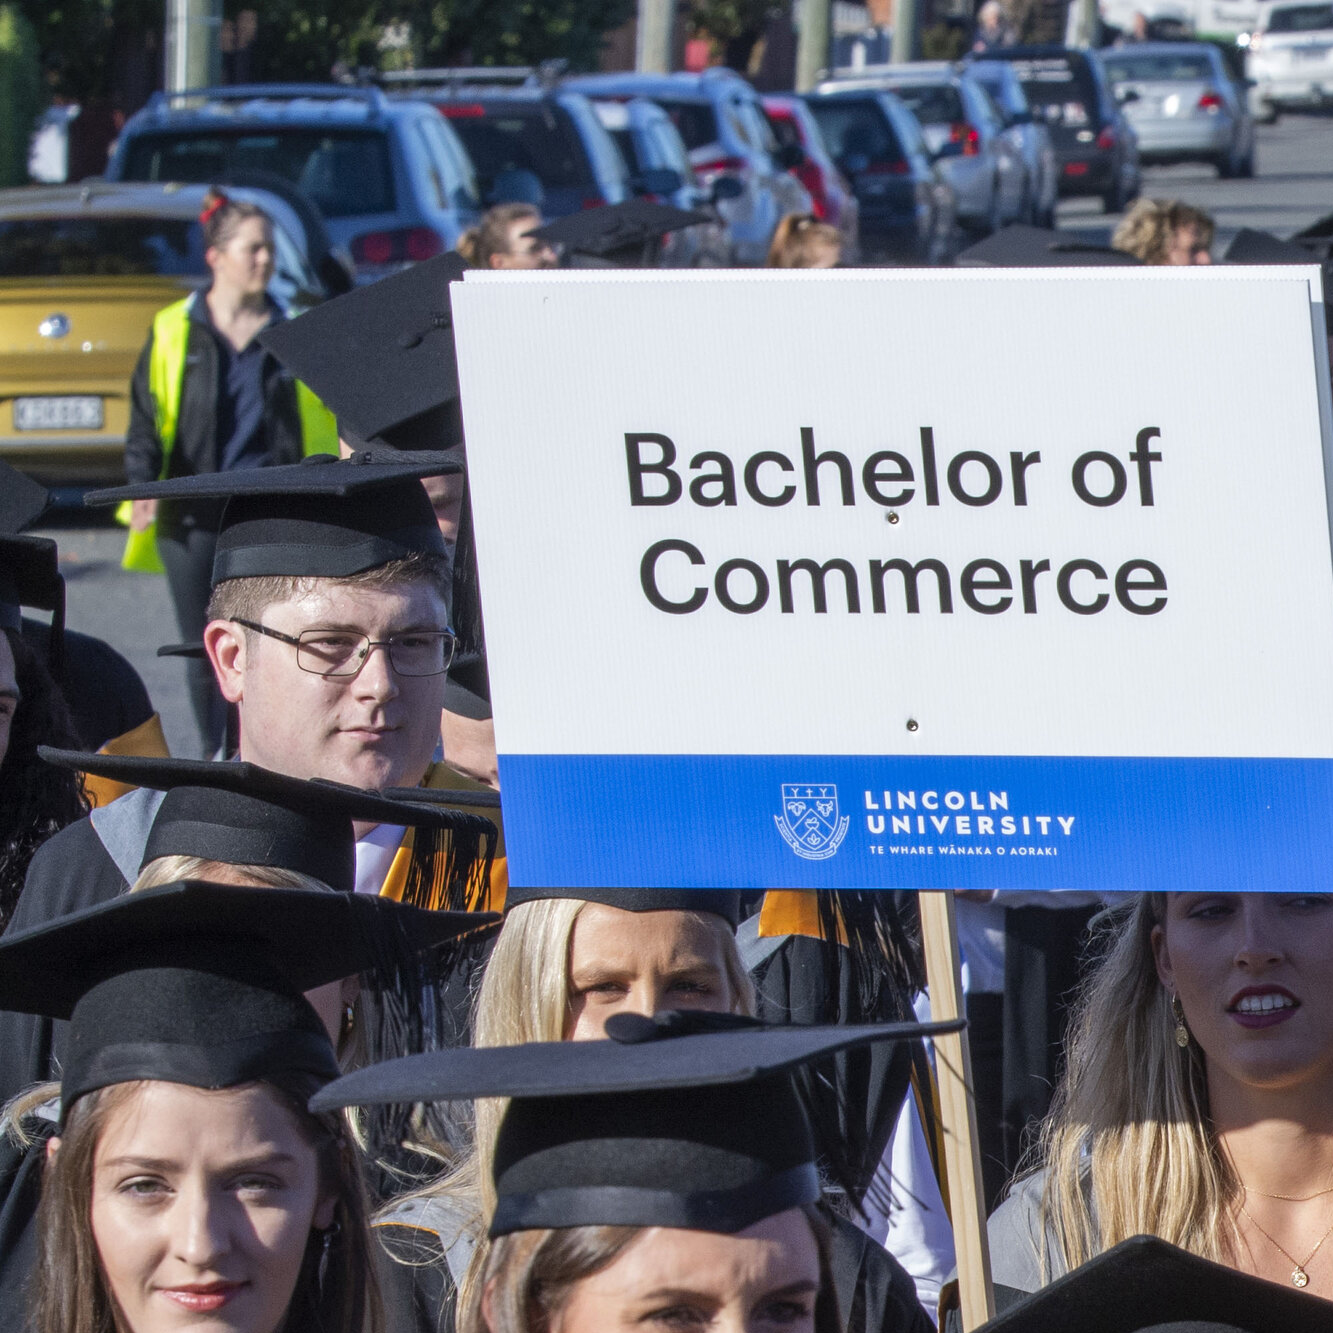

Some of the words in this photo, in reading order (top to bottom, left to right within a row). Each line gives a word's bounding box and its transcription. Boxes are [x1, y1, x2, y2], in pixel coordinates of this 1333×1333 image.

[624, 427, 1041, 507] Bachelor
[1072, 427, 1162, 507] of
[640, 539, 1168, 615] Commerce
[865, 791, 1008, 810] LINCOLN
[867, 815, 1076, 836] UNIVERSITY
[869, 845, 885, 855] TE
[889, 845, 934, 855] WHARE
[938, 843, 992, 856] WĀNAKA
[996, 846, 1006, 856] O
[1010, 846, 1058, 856] AORAKI
